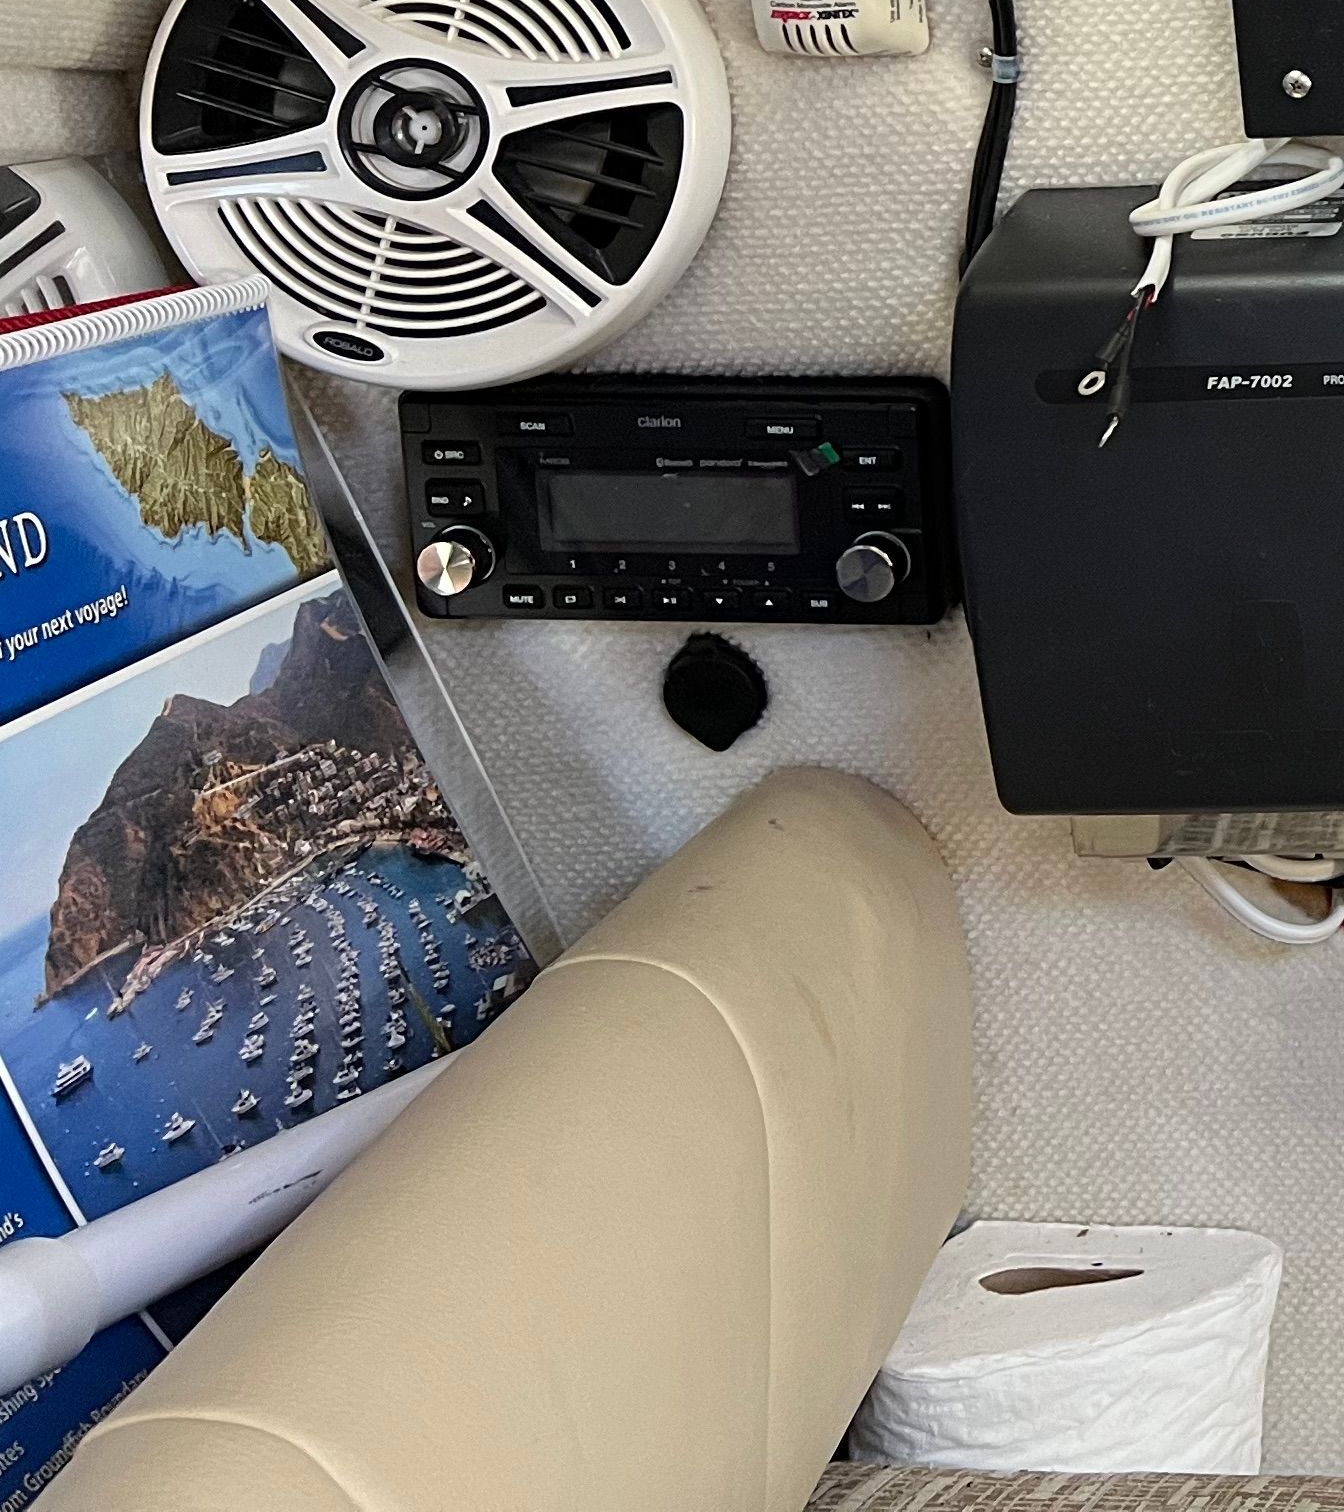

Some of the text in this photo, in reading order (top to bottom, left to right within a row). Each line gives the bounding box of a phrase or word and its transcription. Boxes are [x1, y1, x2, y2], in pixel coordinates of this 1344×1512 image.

[1201, 200, 1254, 216] RESISTANT
[1207, 374, 1293, 390] FAP-7002
[520, 421, 546, 431] SCAN
[766, 425, 794, 435] MENU
[509, 594, 535, 604] MUTE
[5, 584, 128, 661] your next voyage!
